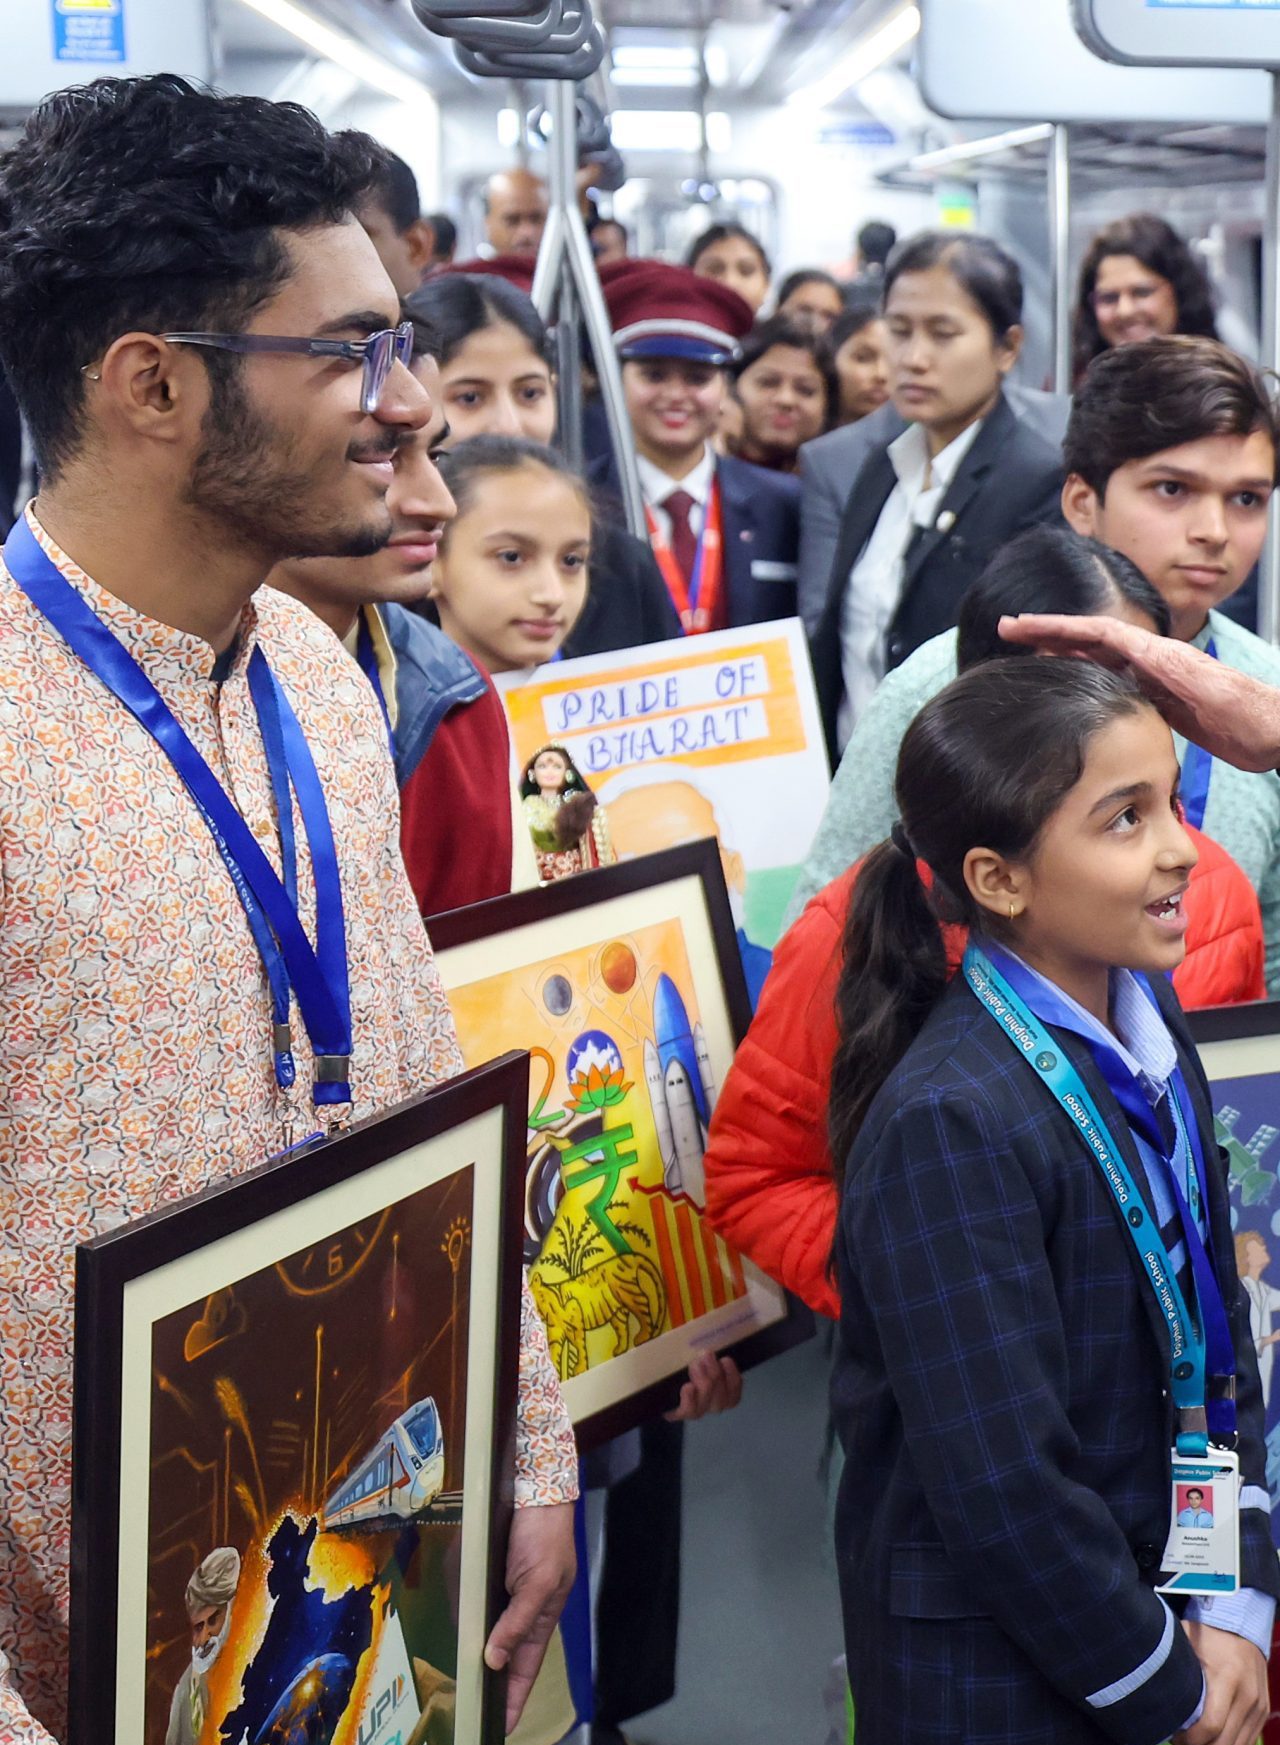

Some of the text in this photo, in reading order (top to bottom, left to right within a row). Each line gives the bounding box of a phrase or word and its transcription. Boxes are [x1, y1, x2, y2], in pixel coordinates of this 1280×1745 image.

[557, 661, 756, 732] PRIDE OF
[584, 705, 749, 773] BHARAT
[983, 988, 1007, 1016] Public
[1004, 1013, 1036, 1052] Dolphin
[1062, 1093, 1090, 1128] School
[1087, 1127, 1108, 1161] Public
[1106, 1161, 1129, 1204] Dolphin
[327, 1243, 344, 1278] 6
[1144, 1251, 1165, 1287] School
[1160, 1286, 1176, 1320] Public
[1172, 1320, 1183, 1359] Dolphin
